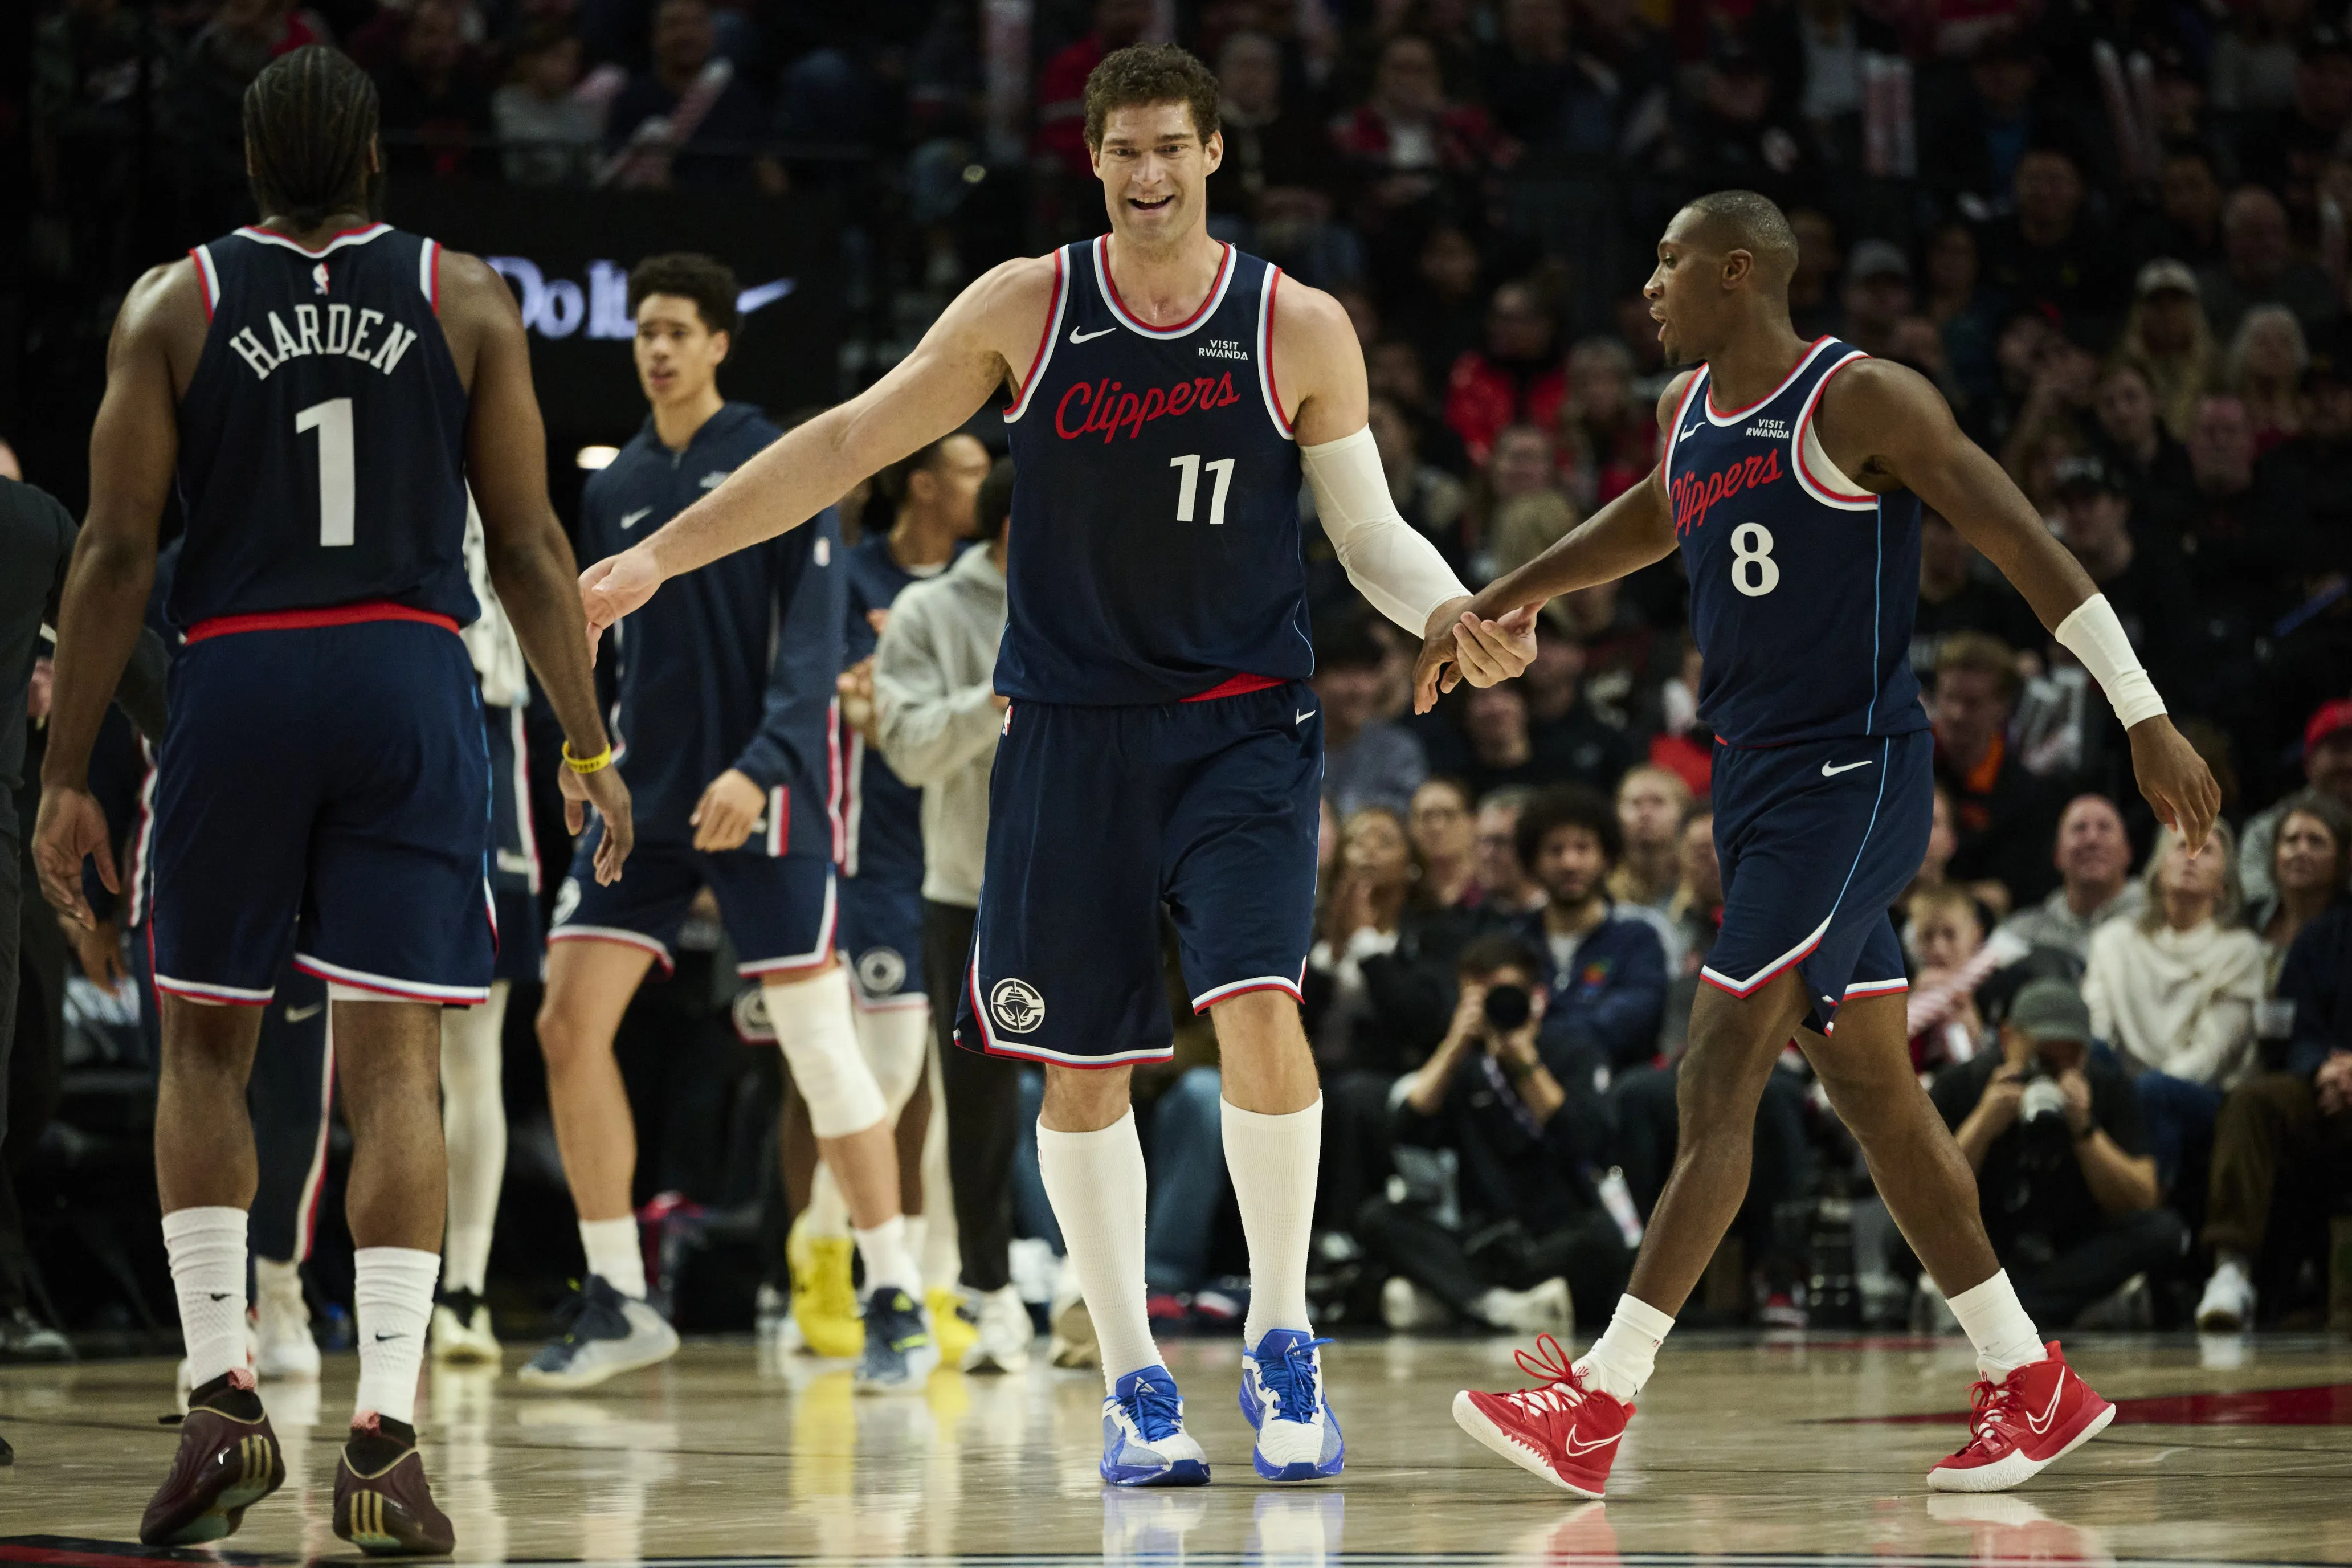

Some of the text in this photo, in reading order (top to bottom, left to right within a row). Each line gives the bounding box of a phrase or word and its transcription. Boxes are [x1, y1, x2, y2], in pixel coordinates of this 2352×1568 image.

[229, 303, 418, 381] HARDEN
[1198, 347, 1248, 360] RWANDA
[1210, 339, 1239, 350] VISIT
[1055, 370, 1241, 444] Clippers
[1746, 427, 1790, 439] RWANDA
[1758, 419, 1785, 428] VISIT
[295, 397, 355, 546] 1
[1170, 454, 1235, 525] 11
[1670, 448, 1783, 539] Clippers
[1730, 522, 1780, 597] 8
